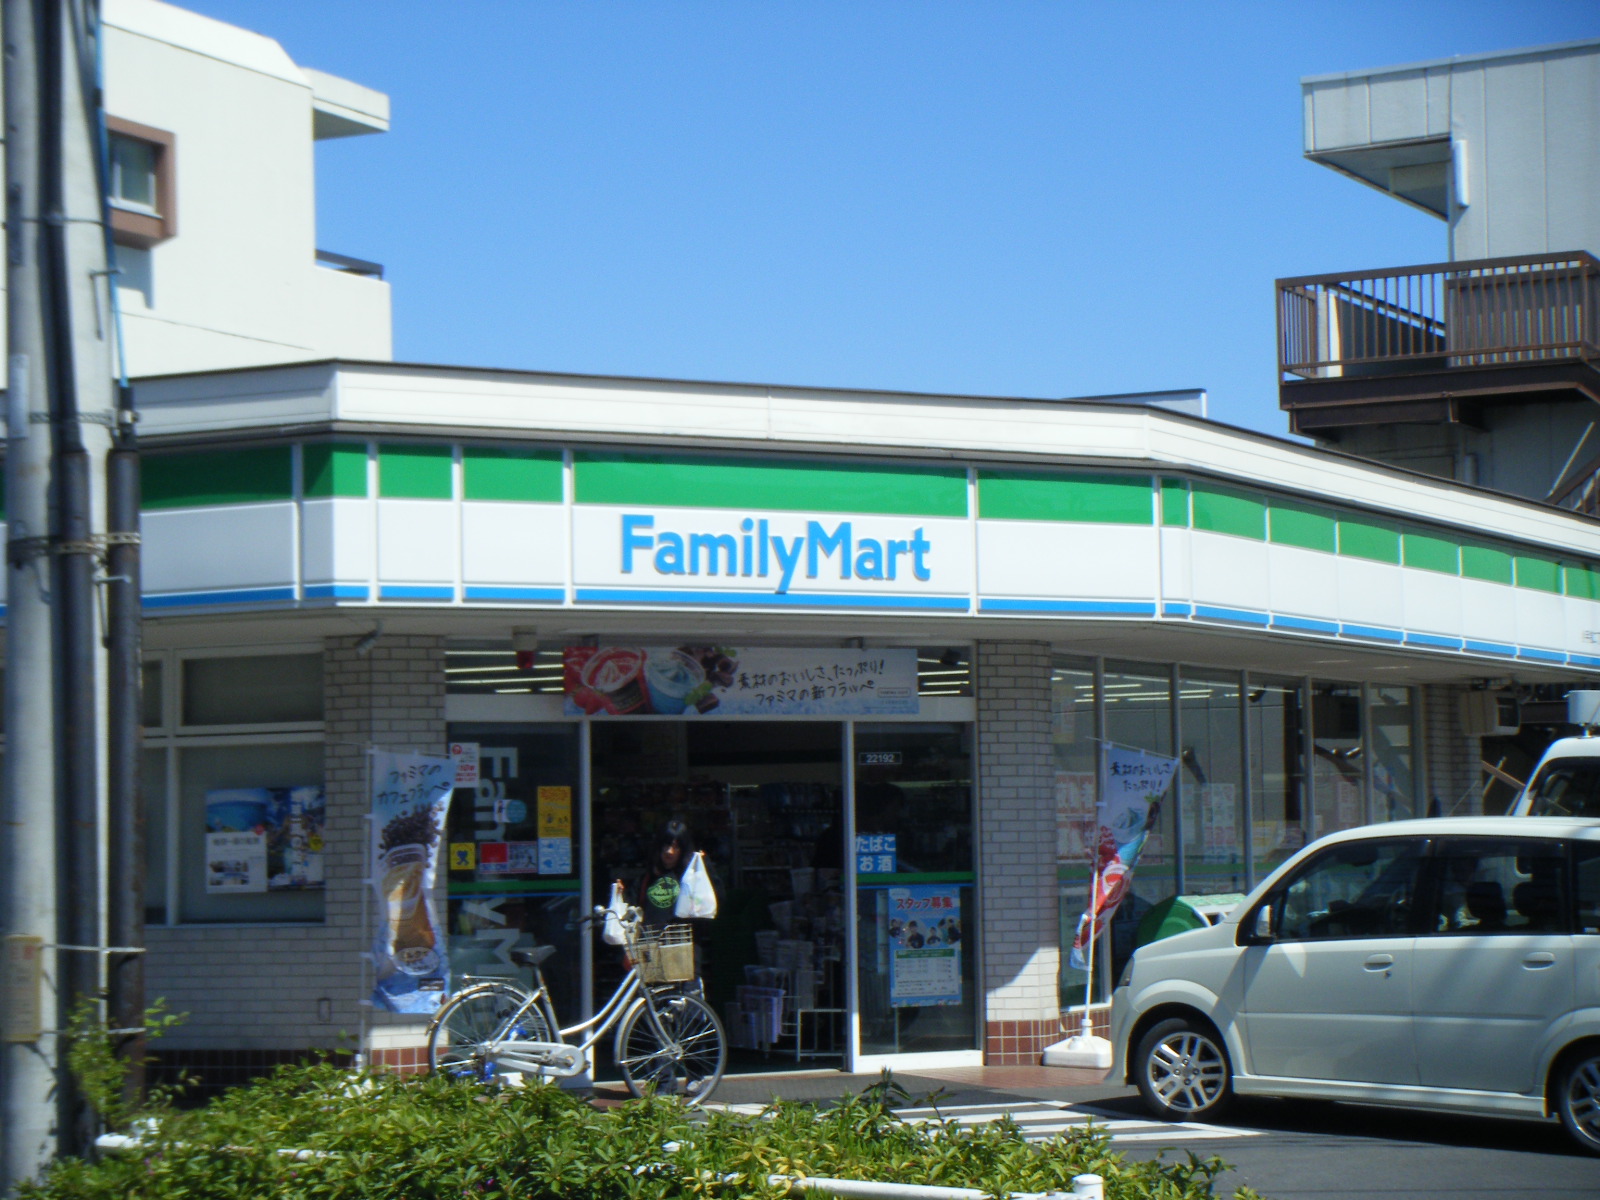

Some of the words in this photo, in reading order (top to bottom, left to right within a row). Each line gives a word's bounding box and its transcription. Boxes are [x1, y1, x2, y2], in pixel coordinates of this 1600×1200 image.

[621, 514, 931, 594] FamilyMart
[866, 753, 895, 764] 22192
[855, 836, 897, 853] たばこ
[859, 855, 893, 872] お酒
[896, 896, 953, 910] スタッフ募集
